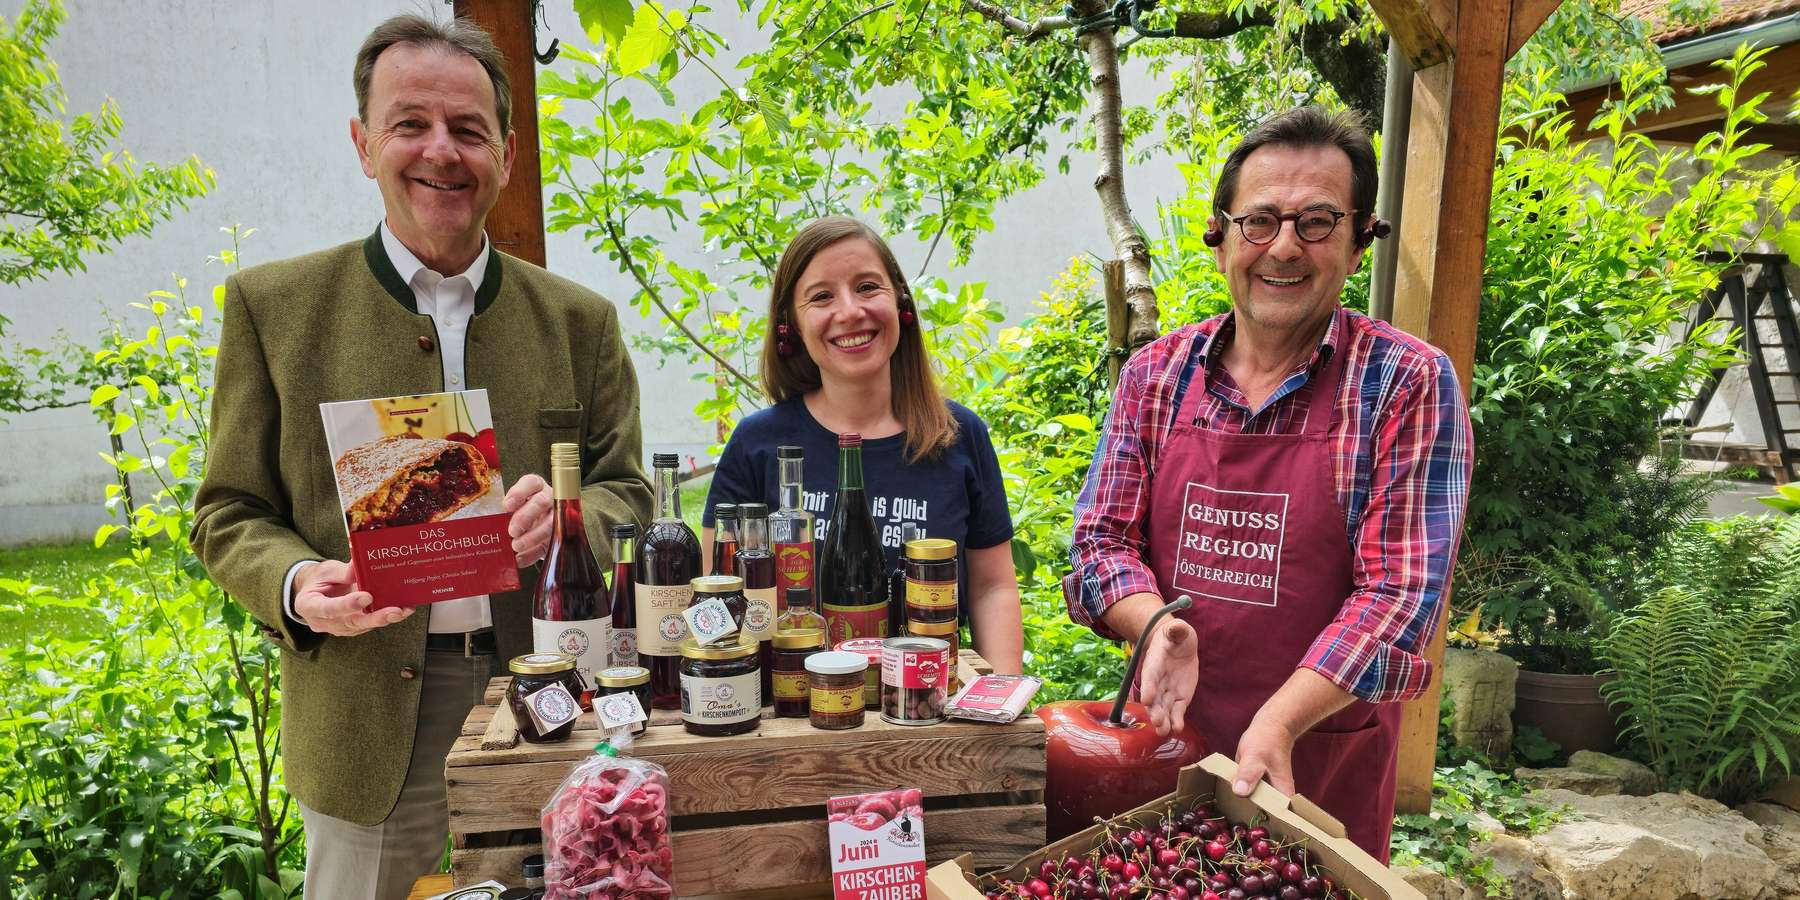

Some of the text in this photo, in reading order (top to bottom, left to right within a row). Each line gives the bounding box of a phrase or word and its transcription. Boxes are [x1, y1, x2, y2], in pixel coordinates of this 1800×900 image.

[888, 497, 928, 523] guid
[1187, 503, 1280, 531] GENUSS
[366, 532, 501, 561] KIRSCH-KOCHBUCH
[419, 527, 446, 540] DAS
[1183, 531, 1277, 562] REGION
[1180, 558, 1273, 589] ÖSTERREICH
[650, 588, 693, 599] KIRSCHEN
[651, 599, 673, 608] SAFT
[702, 707, 746, 719] KIRSCHENKOMPOTT
[706, 699, 742, 711] Oma's
[838, 838, 880, 864] Juni
[839, 864, 921, 892] KIRSCHEN-
[858, 882, 922, 900] ZAUBER
